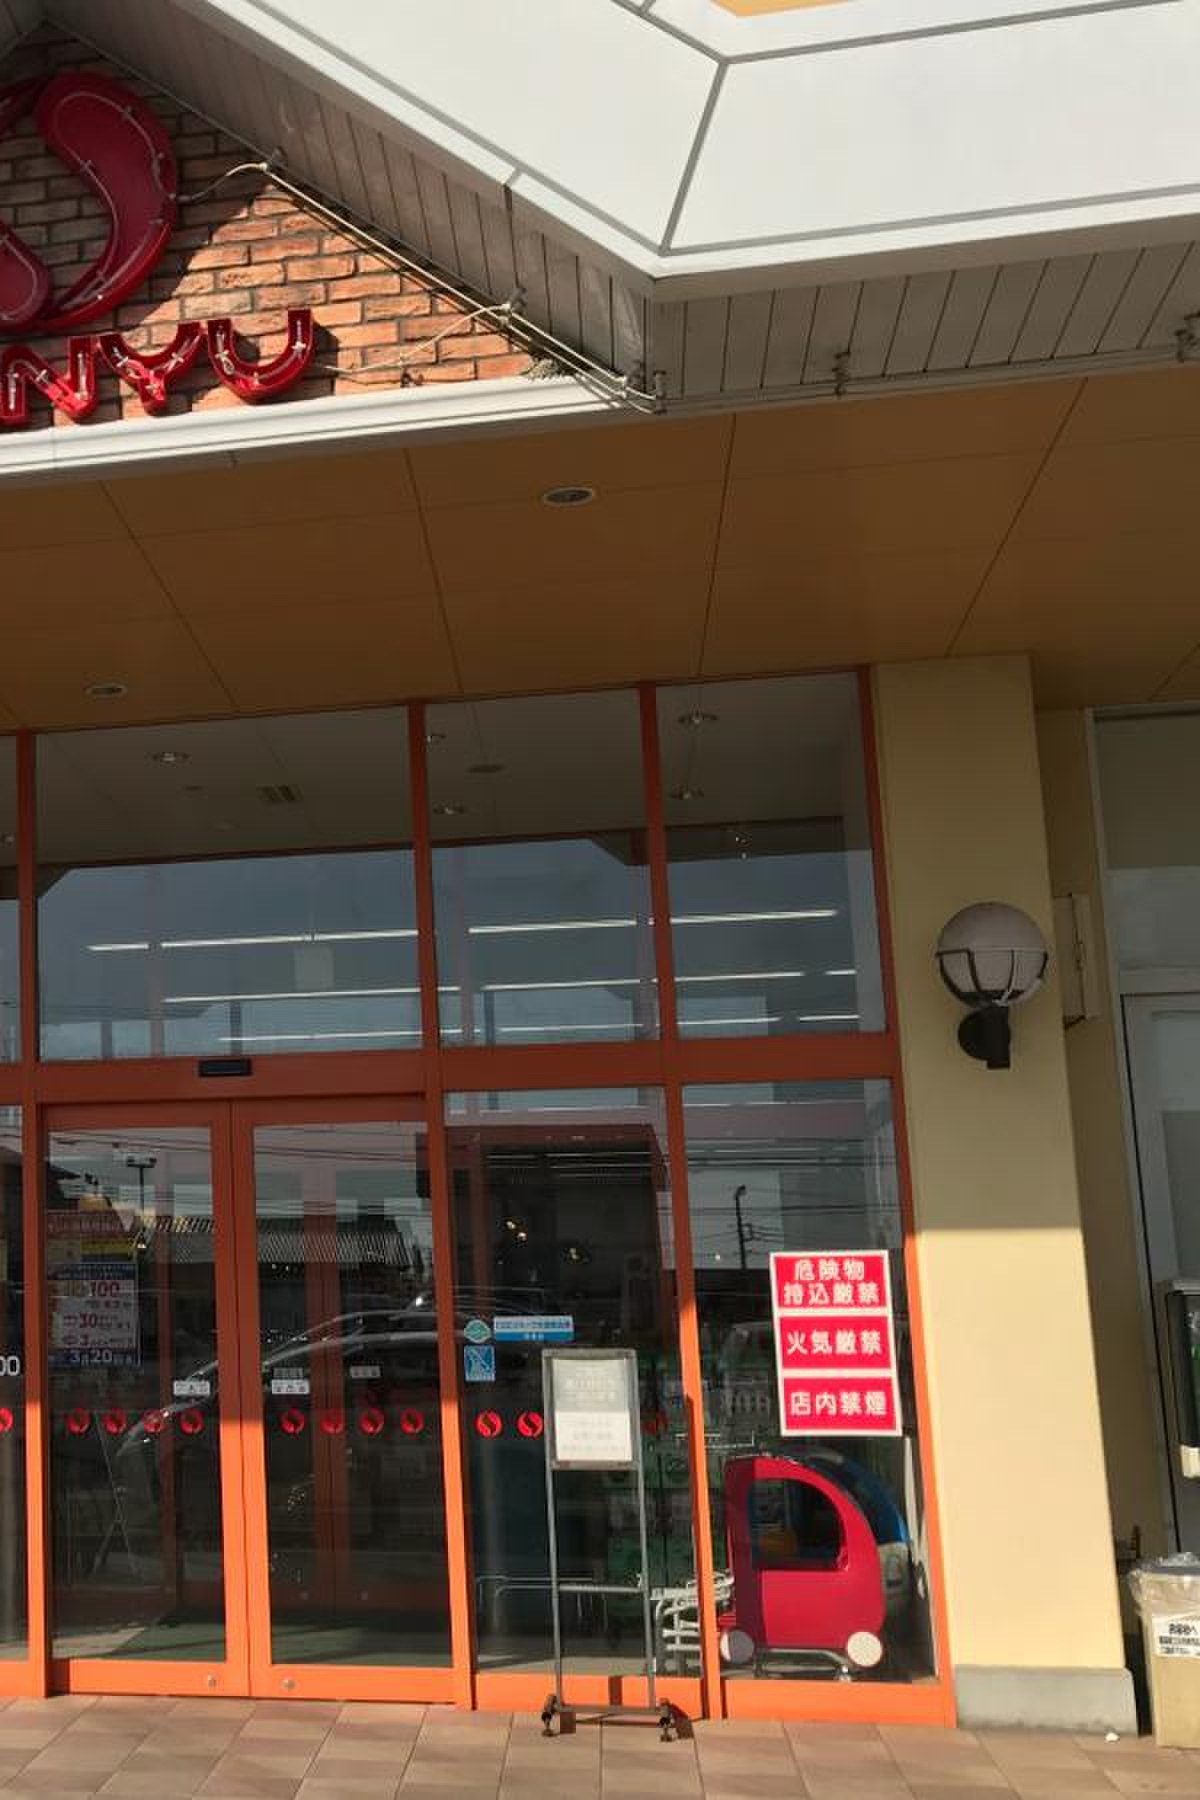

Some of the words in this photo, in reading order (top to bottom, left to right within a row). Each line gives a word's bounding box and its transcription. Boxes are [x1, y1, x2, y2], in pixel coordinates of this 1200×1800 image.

[794, 1258, 866, 1282] 危険物
[783, 1281, 880, 1306] 持込厳禁
[787, 1330, 882, 1355] 火気厳禁
[789, 1391, 887, 1416] 店内禁煙
